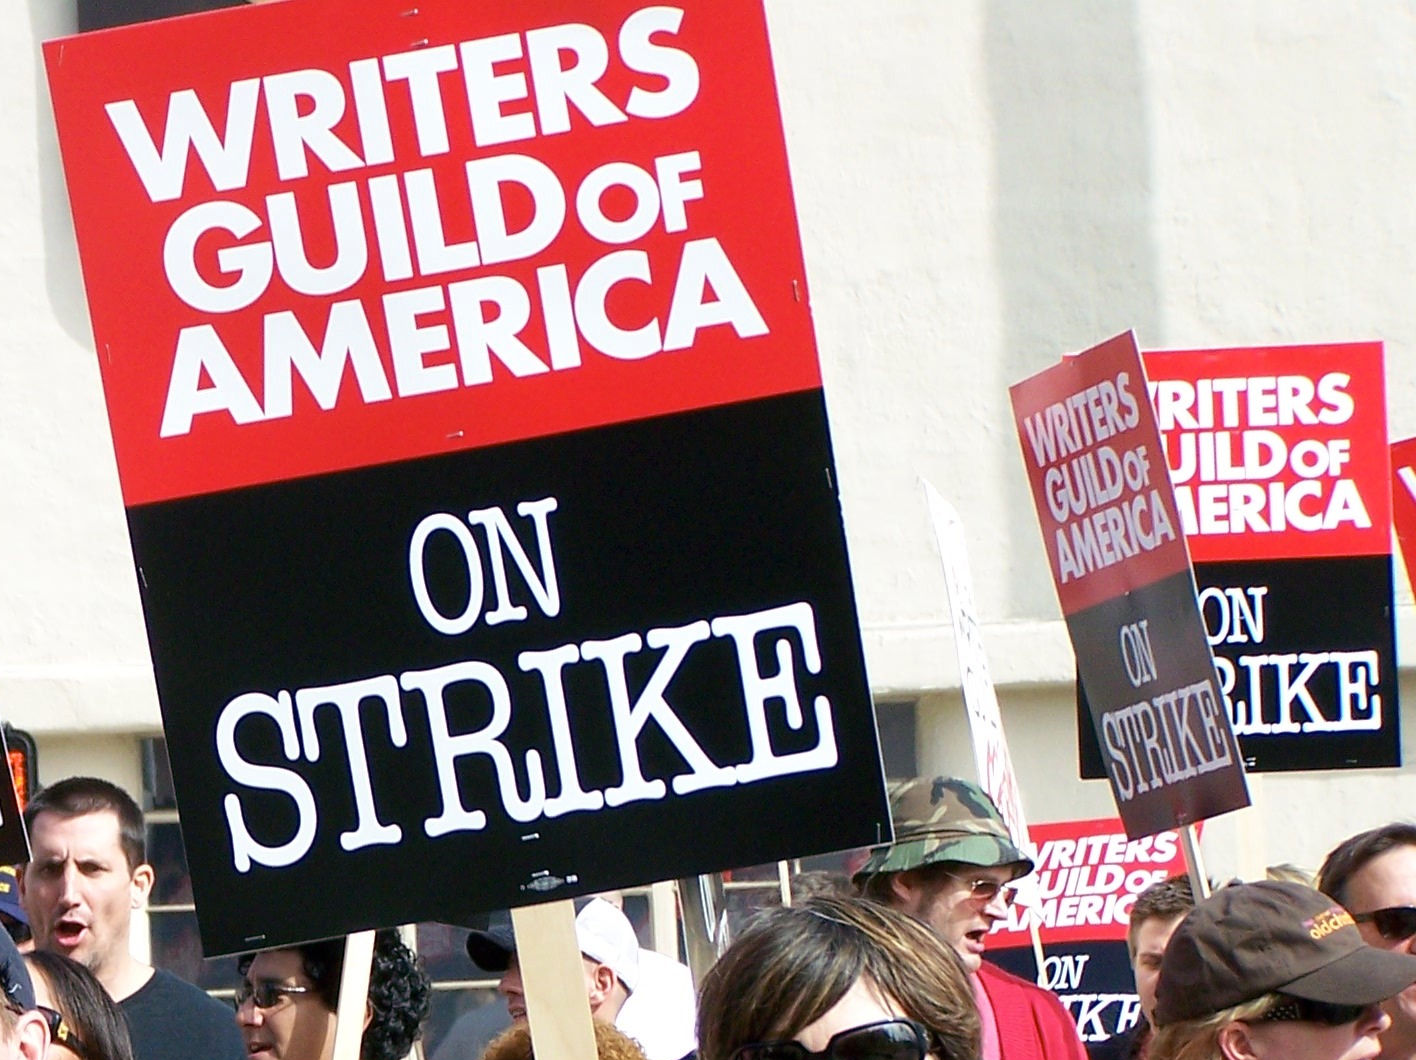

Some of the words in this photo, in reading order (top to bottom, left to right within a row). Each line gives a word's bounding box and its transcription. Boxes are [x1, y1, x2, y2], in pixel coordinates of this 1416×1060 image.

[105, 6, 701, 203] WRITERS
[164, 154, 567, 313] GUILD
[576, 150, 704, 246] OF
[159, 237, 770, 439] AMERICA
[1024, 371, 1140, 468] WRITERS
[1288, 439, 1351, 479] OF
[1045, 445, 1124, 524] GUILD
[1123, 444, 1151, 492] OF
[1055, 489, 1176, 585] AMERICA
[409, 497, 558, 636] ON
[1199, 586, 1268, 646] ON
[1119, 619, 1158, 688] ON
[214, 601, 840, 873] STRIKE
[1101, 679, 1233, 802] STRIKE
